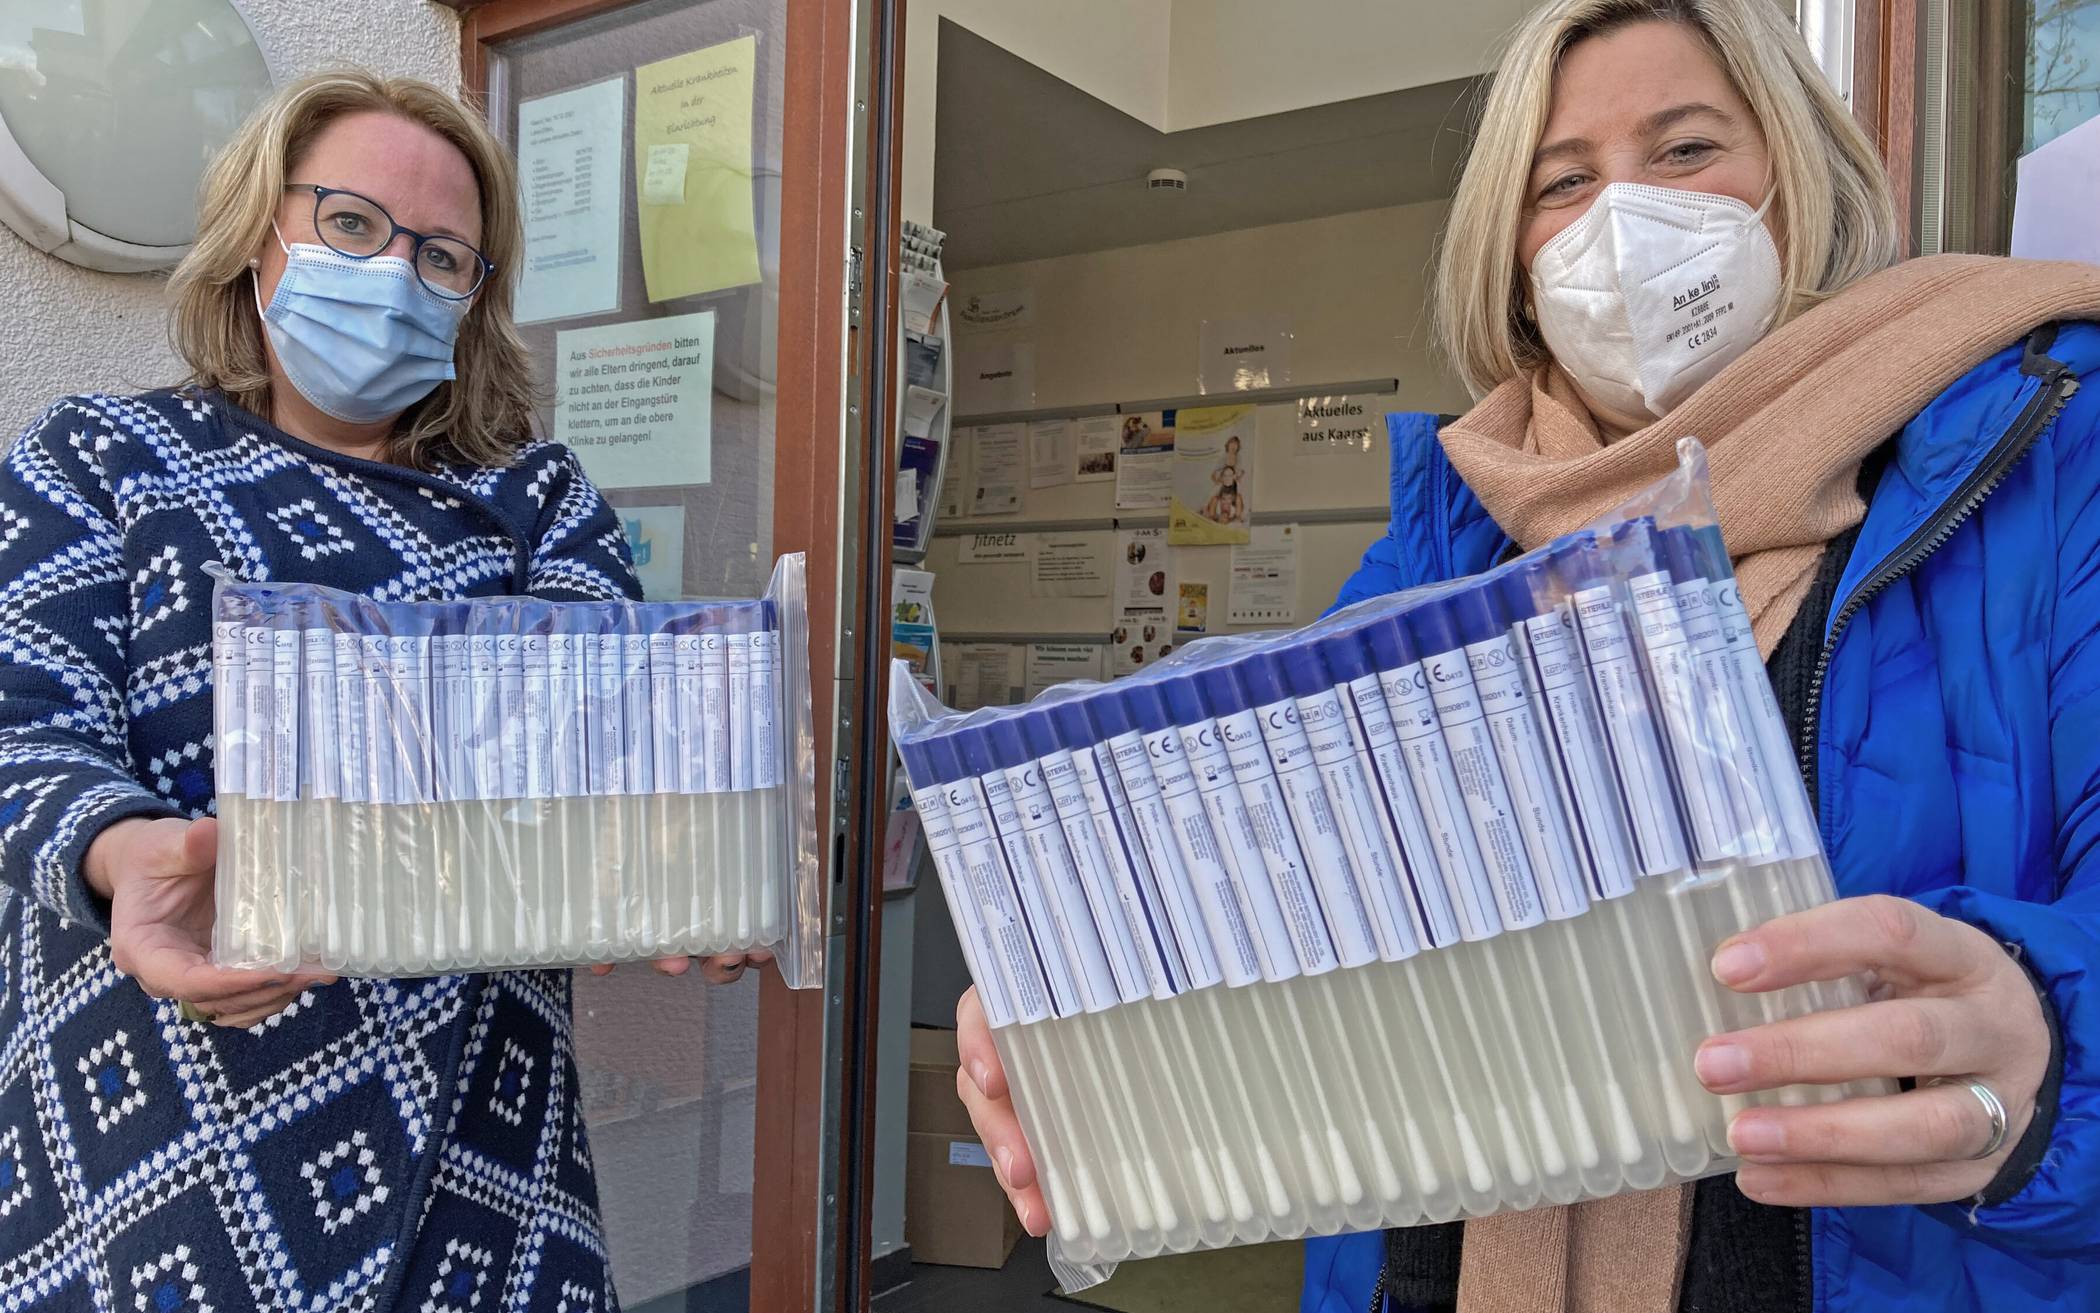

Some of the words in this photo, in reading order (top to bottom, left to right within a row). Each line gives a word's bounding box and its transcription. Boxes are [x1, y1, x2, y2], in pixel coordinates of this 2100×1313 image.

[1673, 294, 1687, 309] An
[1687, 287, 1700, 300] ke
[570, 351, 586, 361] Aus
[588, 341, 673, 360] Sicherheitsgründen
[674, 337, 700, 349] bitten
[570, 367, 582, 378] wir
[583, 365, 599, 377] alle
[601, 363, 627, 376] Eltern
[629, 357, 671, 373] dringend,
[672, 352, 701, 367] darauf
[569, 386, 580, 395] zu
[581, 383, 612, 395] achten,
[614, 380, 635, 391] dass
[637, 377, 651, 389] die
[652, 374, 681, 387] Kinder
[568, 401, 590, 412] nicht
[591, 402, 602, 410] an
[604, 398, 618, 409] der
[621, 393, 678, 409] Eingangstüre
[1302, 403, 1363, 419] Aktuelles
[568, 417, 602, 430] klettern,
[604, 417, 618, 427] um
[620, 416, 632, 425] an
[633, 413, 647, 424] die
[648, 412, 674, 423] obere
[567, 435, 594, 447] Klinke
[595, 436, 607, 445] zu
[1302, 430, 1325, 442] aus
[1444, 670, 1464, 681] 0413
[1599, 670, 1616, 719] Krankenhaus
[1506, 717, 1517, 741] Datum
[1553, 695, 1571, 744] Krankenhaus
[1235, 731, 1253, 742] 0413
[1413, 744, 1425, 769] Datum
[1441, 831, 1454, 858] Stunde
